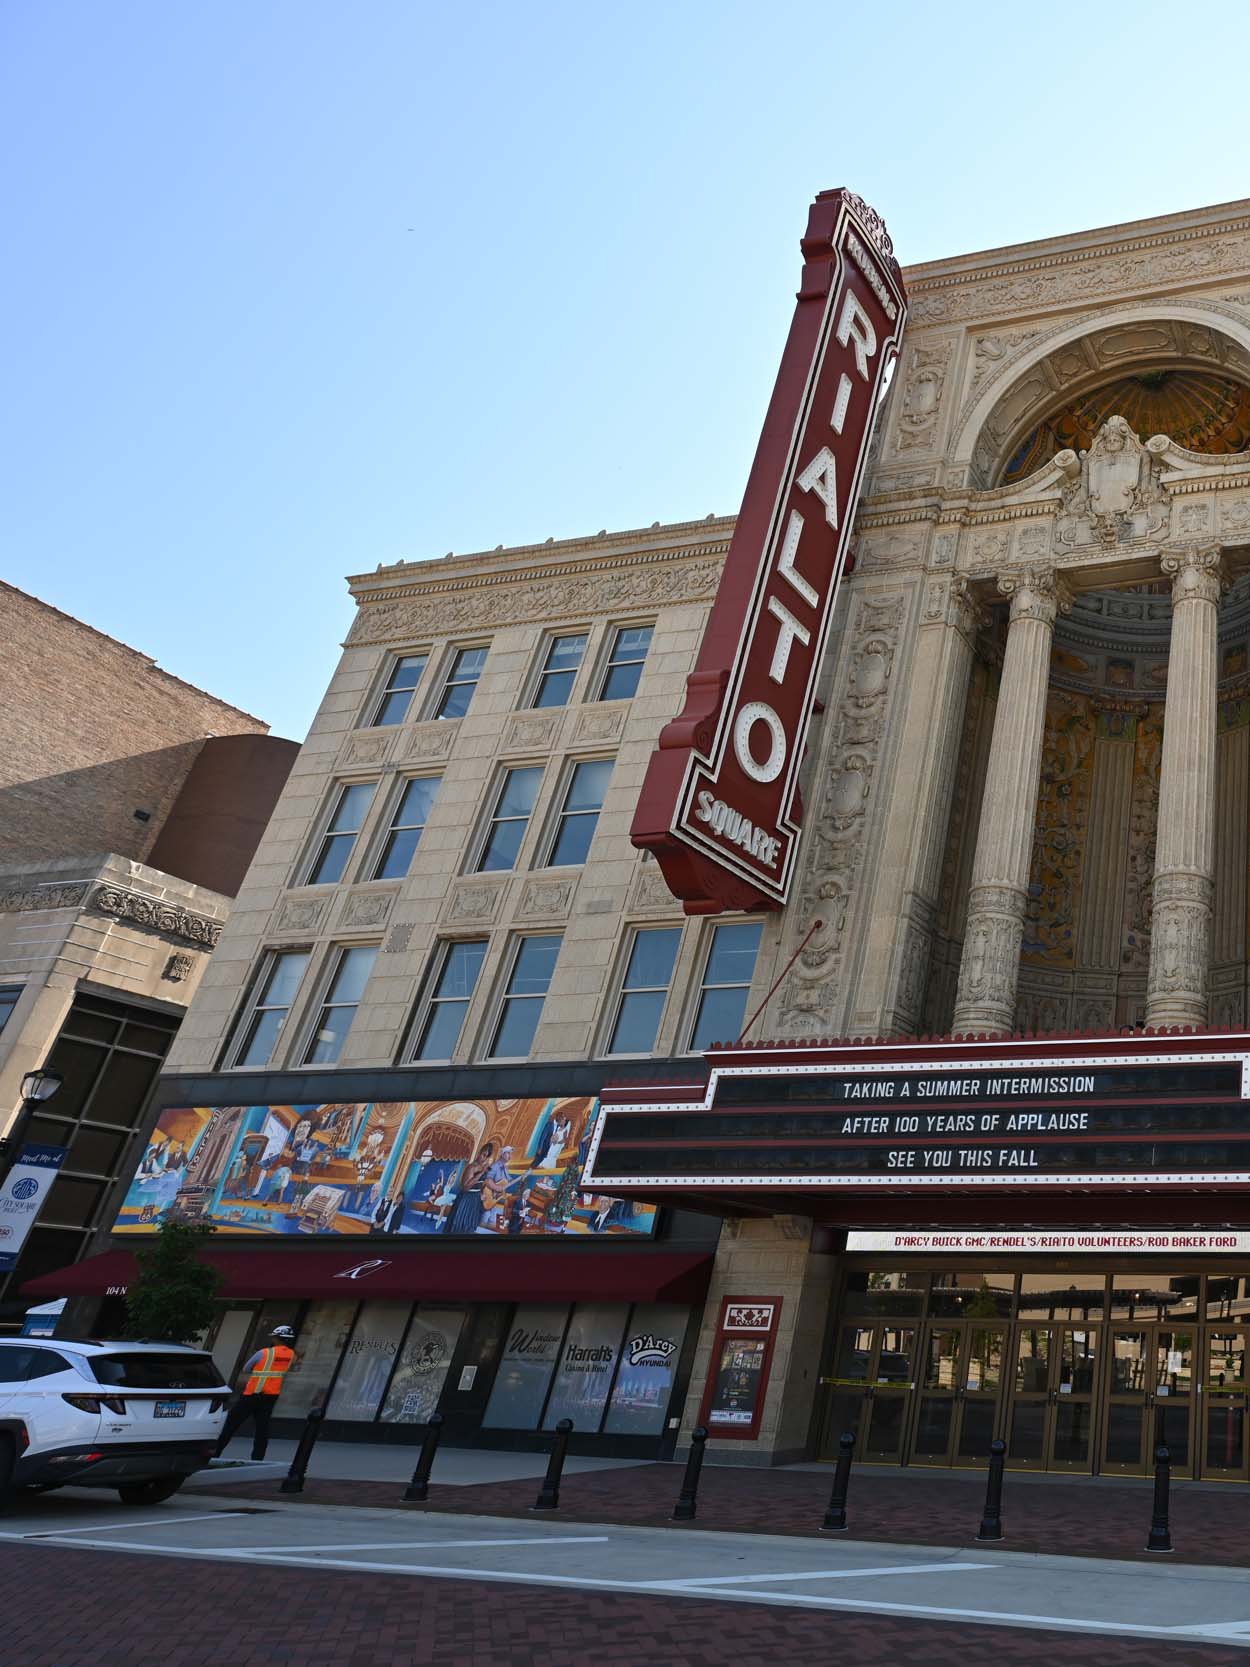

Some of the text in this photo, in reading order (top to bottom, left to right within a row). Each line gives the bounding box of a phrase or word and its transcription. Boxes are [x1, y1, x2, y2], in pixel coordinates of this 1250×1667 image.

[734, 288, 877, 783] RIALTO
[695, 790, 782, 869] SQUARE
[843, 1076, 1095, 1098] TAKING A SUMMER INTERMISSION
[841, 1117, 889, 1134] AFTER
[927, 1115, 975, 1132] YEARS
[980, 1114, 1000, 1131] OF
[1006, 1113, 1089, 1131] APPLAUSE
[888, 1149, 1039, 1168] SEE YOU THIS FALL
[894, 1236, 930, 1247] D'ARCY
[931, 1236, 962, 1247] BUICK
[1077, 1236, 1169, 1247] VOLUNTEERS/ROD
[1171, 1236, 1206, 1247] BAKER
[1209, 1236, 1237, 1247] FORD
[105, 1286, 119, 1295] 104
[565, 1344, 613, 1362] Harrah's
[631, 1336, 677, 1356] D'Arcy
[639, 1359, 672, 1367] HYUNDAI
